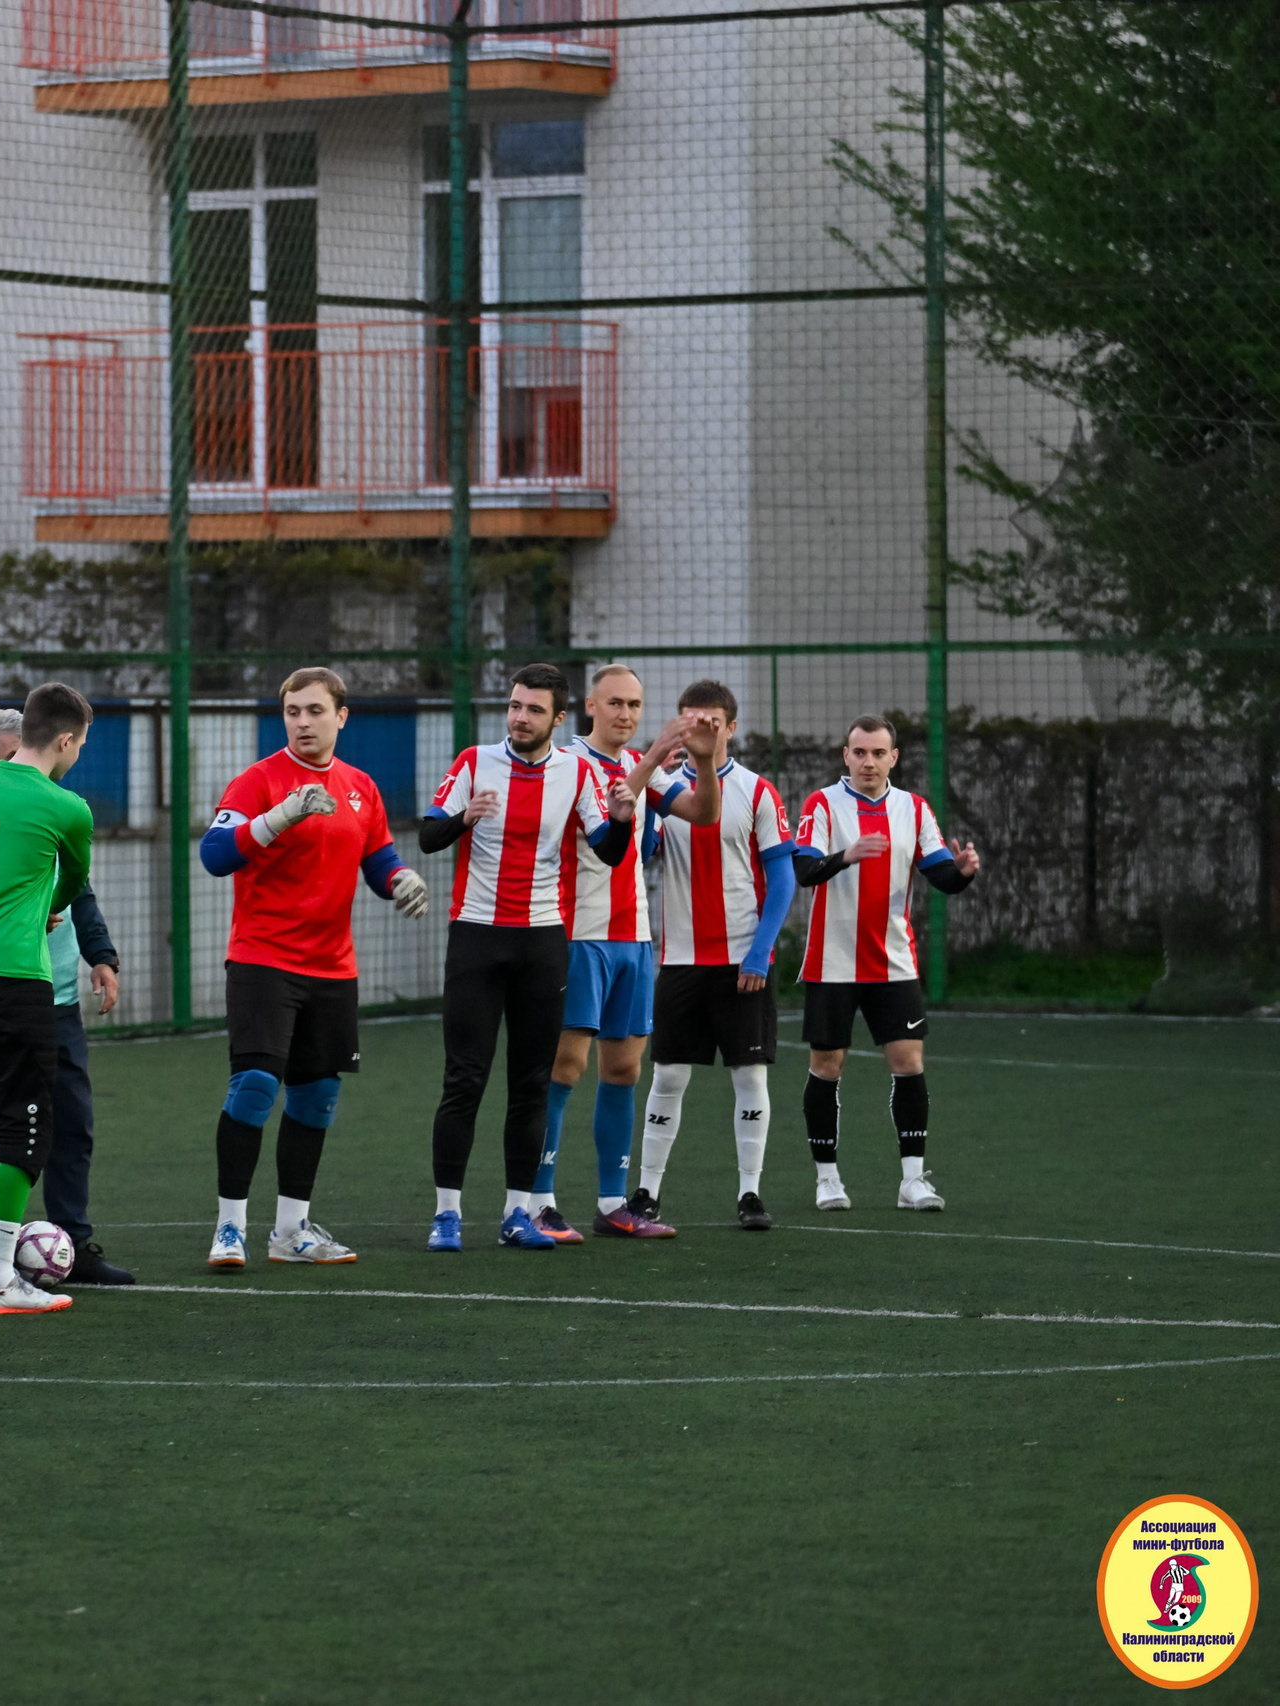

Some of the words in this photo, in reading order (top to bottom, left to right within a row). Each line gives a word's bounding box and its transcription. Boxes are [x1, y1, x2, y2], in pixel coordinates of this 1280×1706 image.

[648, 1113, 671, 1126] 2K
[741, 1110, 762, 1121] 2K
[540, 1151, 556, 1165] K
